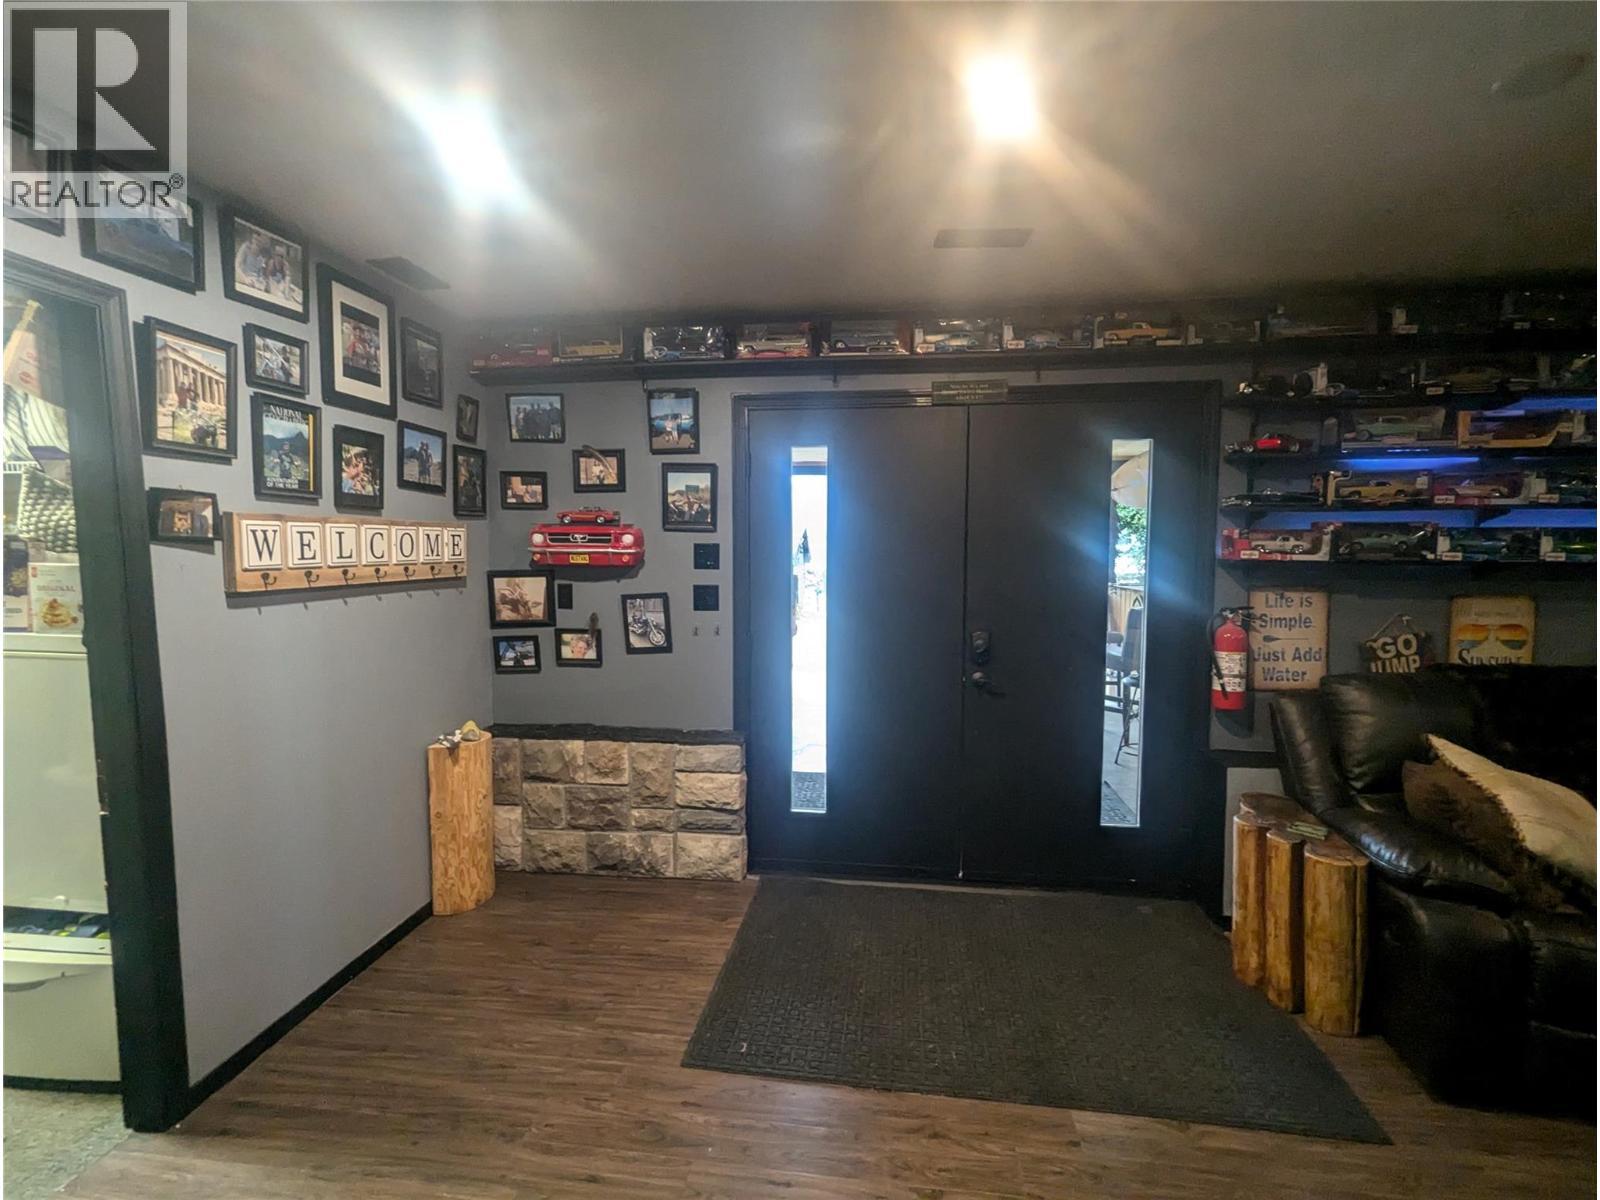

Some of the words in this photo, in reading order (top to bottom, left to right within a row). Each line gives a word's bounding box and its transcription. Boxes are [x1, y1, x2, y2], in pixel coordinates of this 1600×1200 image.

[250, 528, 463, 563] WELCOME
[1264, 592, 1294, 609] Life
[1299, 592, 1313, 608] is
[1253, 646, 1286, 662] Just
[1292, 646, 1323, 662] Add
[1376, 633, 1418, 659] GO
